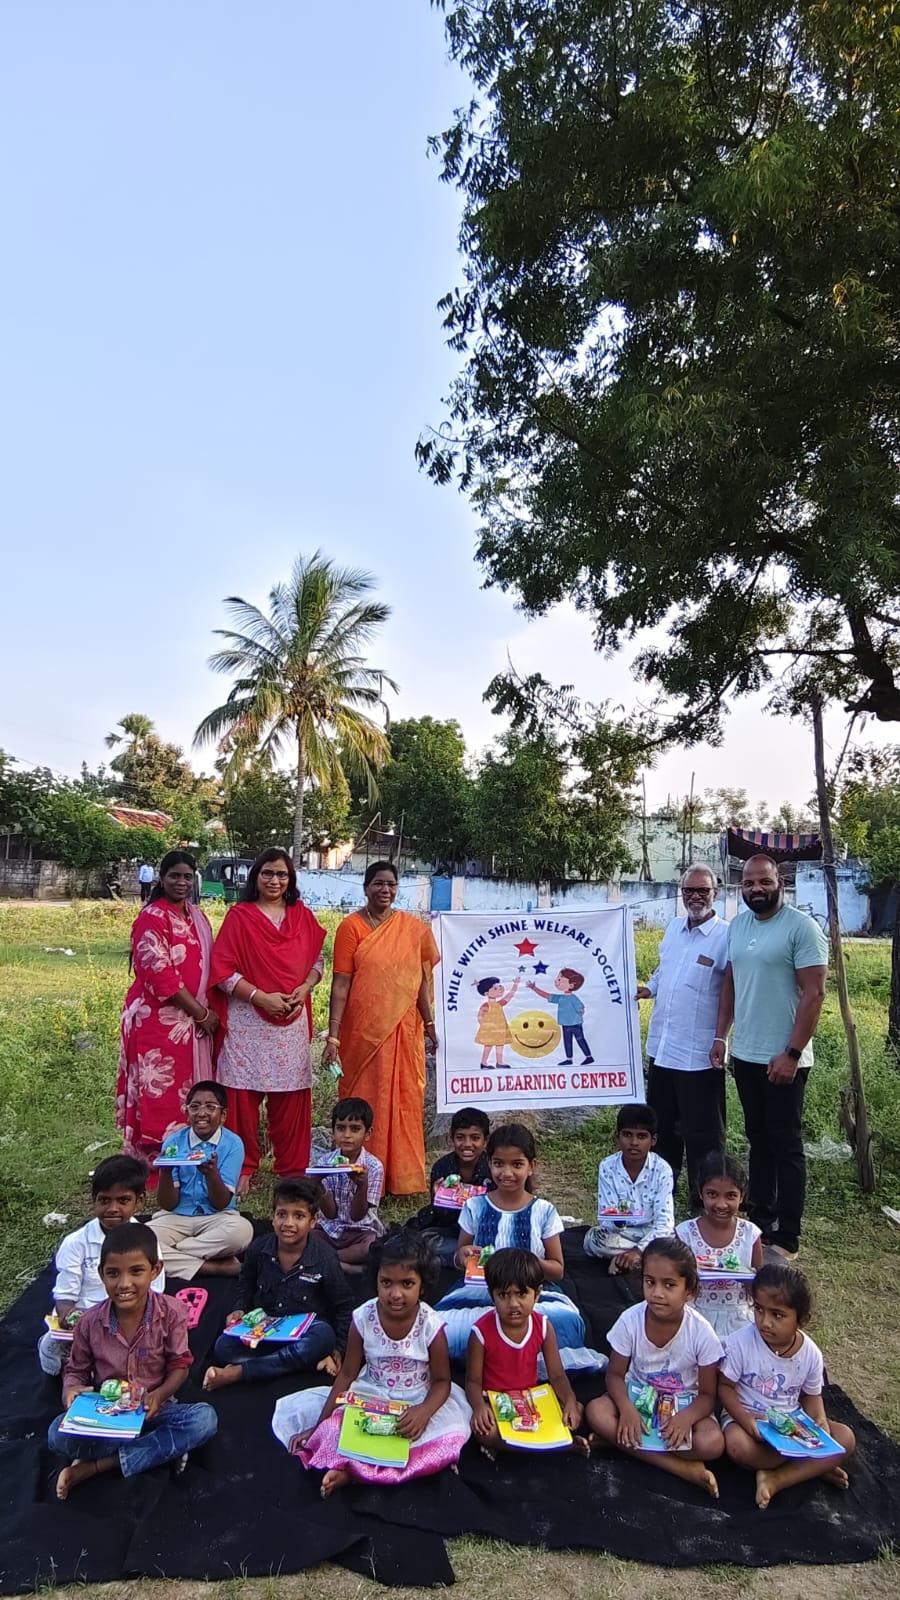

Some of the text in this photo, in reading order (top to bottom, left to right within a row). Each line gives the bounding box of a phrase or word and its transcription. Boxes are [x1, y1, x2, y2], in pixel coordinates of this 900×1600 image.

[447, 919, 622, 1012] SMILE WITH SHINE WELFARE SOCIETY
[451, 1072, 627, 1094] CHILD LEARNING CENTRE
